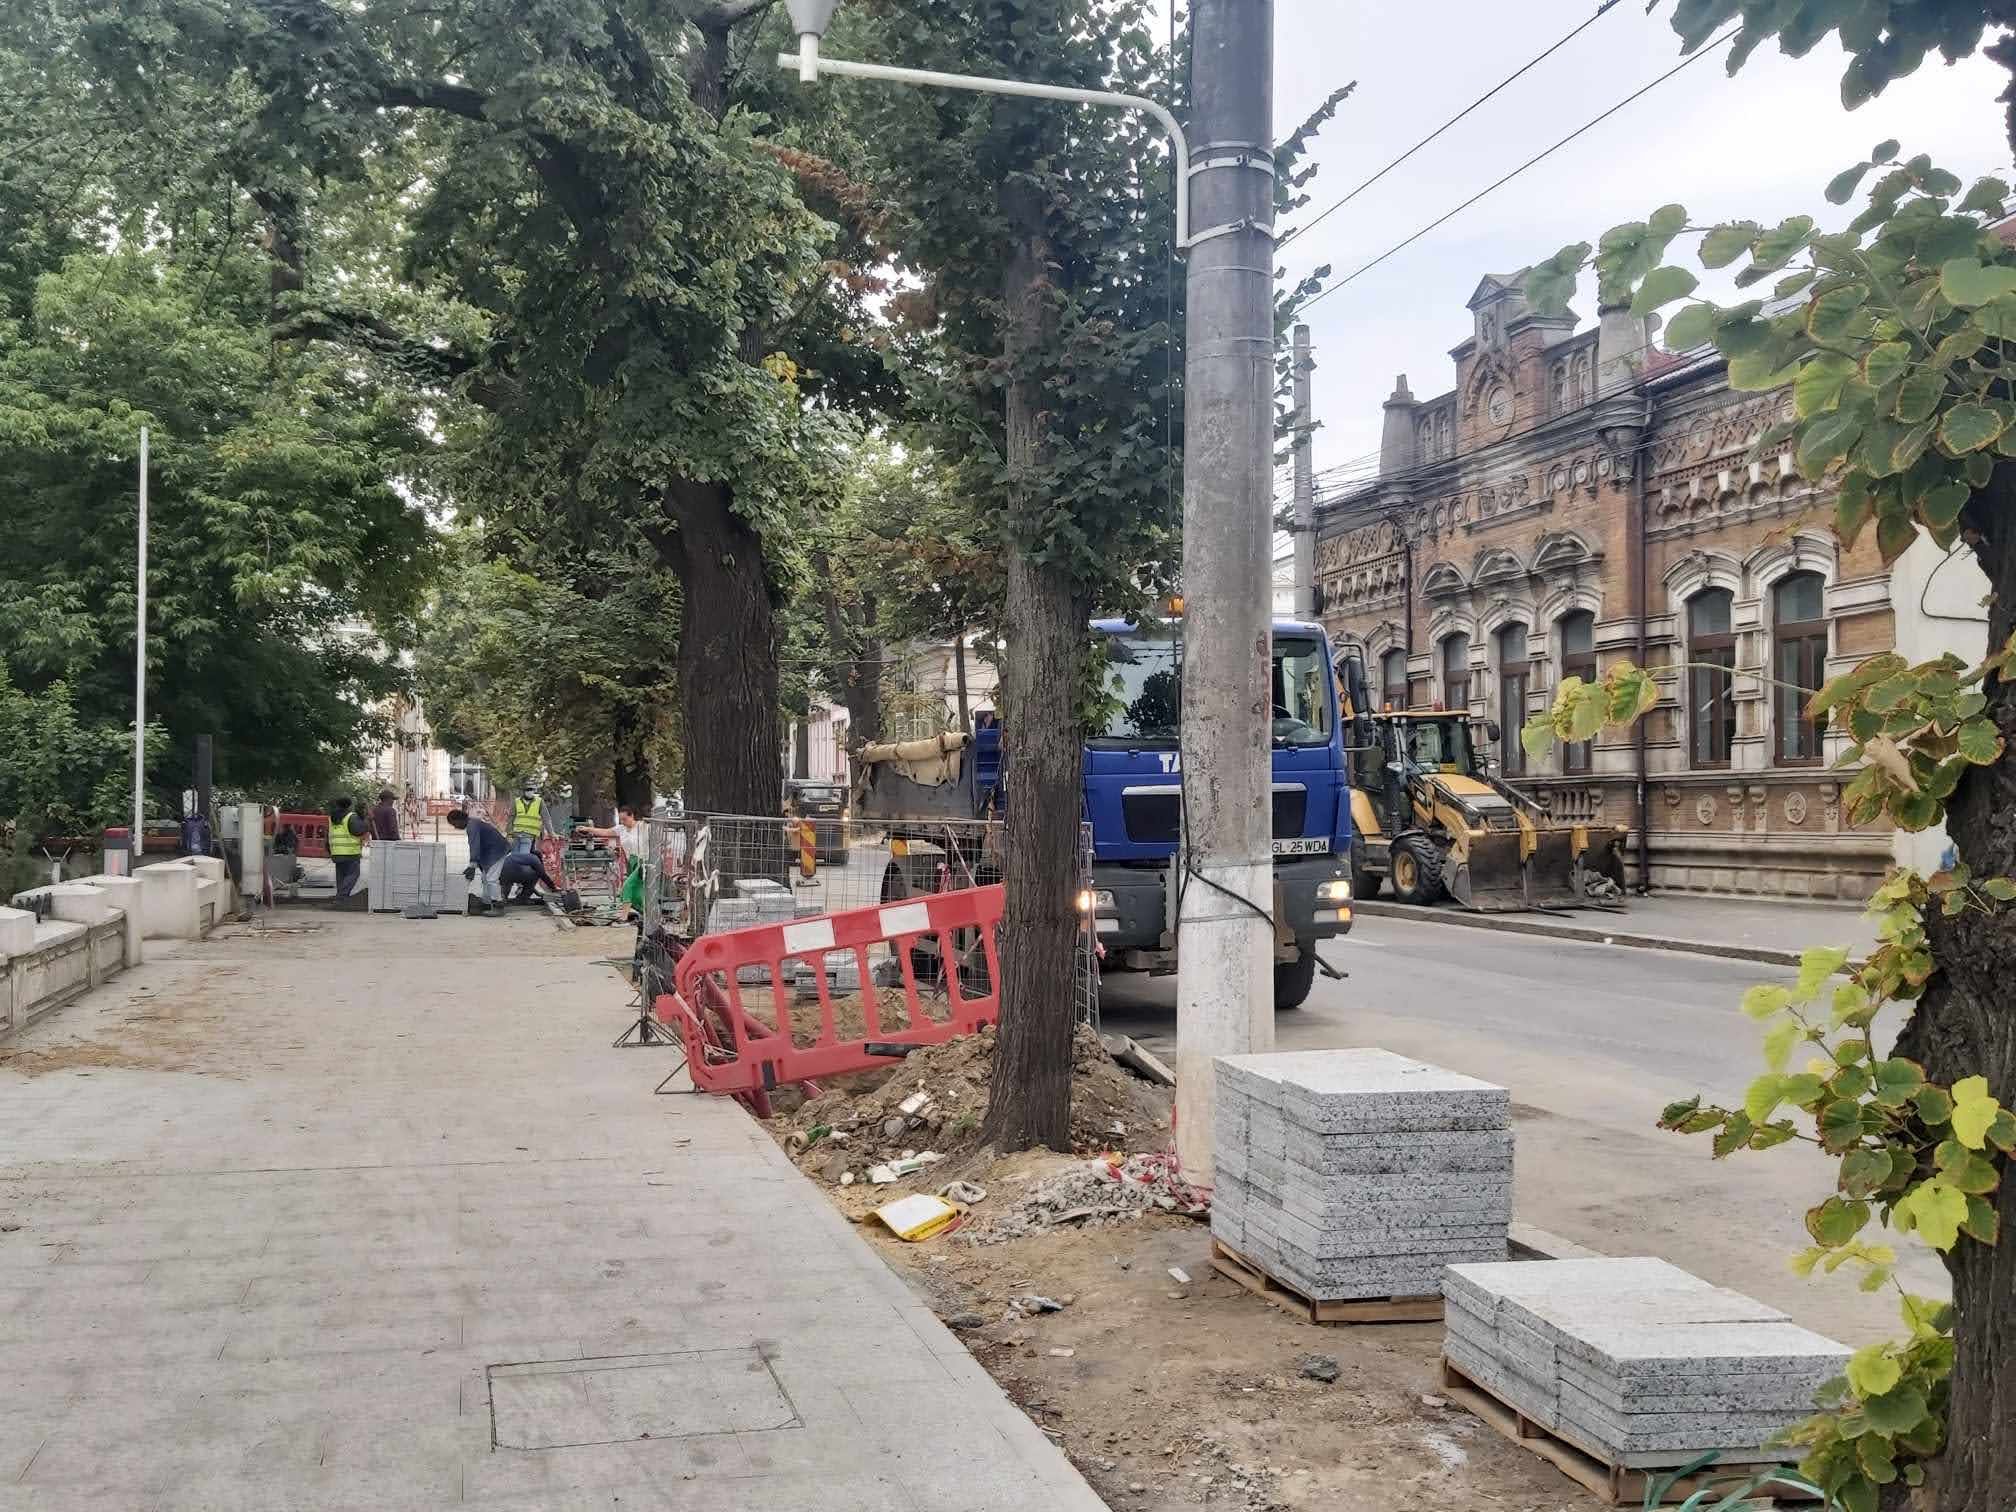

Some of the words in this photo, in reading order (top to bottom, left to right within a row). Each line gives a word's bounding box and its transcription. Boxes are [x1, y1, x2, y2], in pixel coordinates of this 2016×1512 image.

[1272, 841, 1286, 853] GL
[1290, 841, 1303, 853] 25
[1305, 840, 1327, 852] WDA
